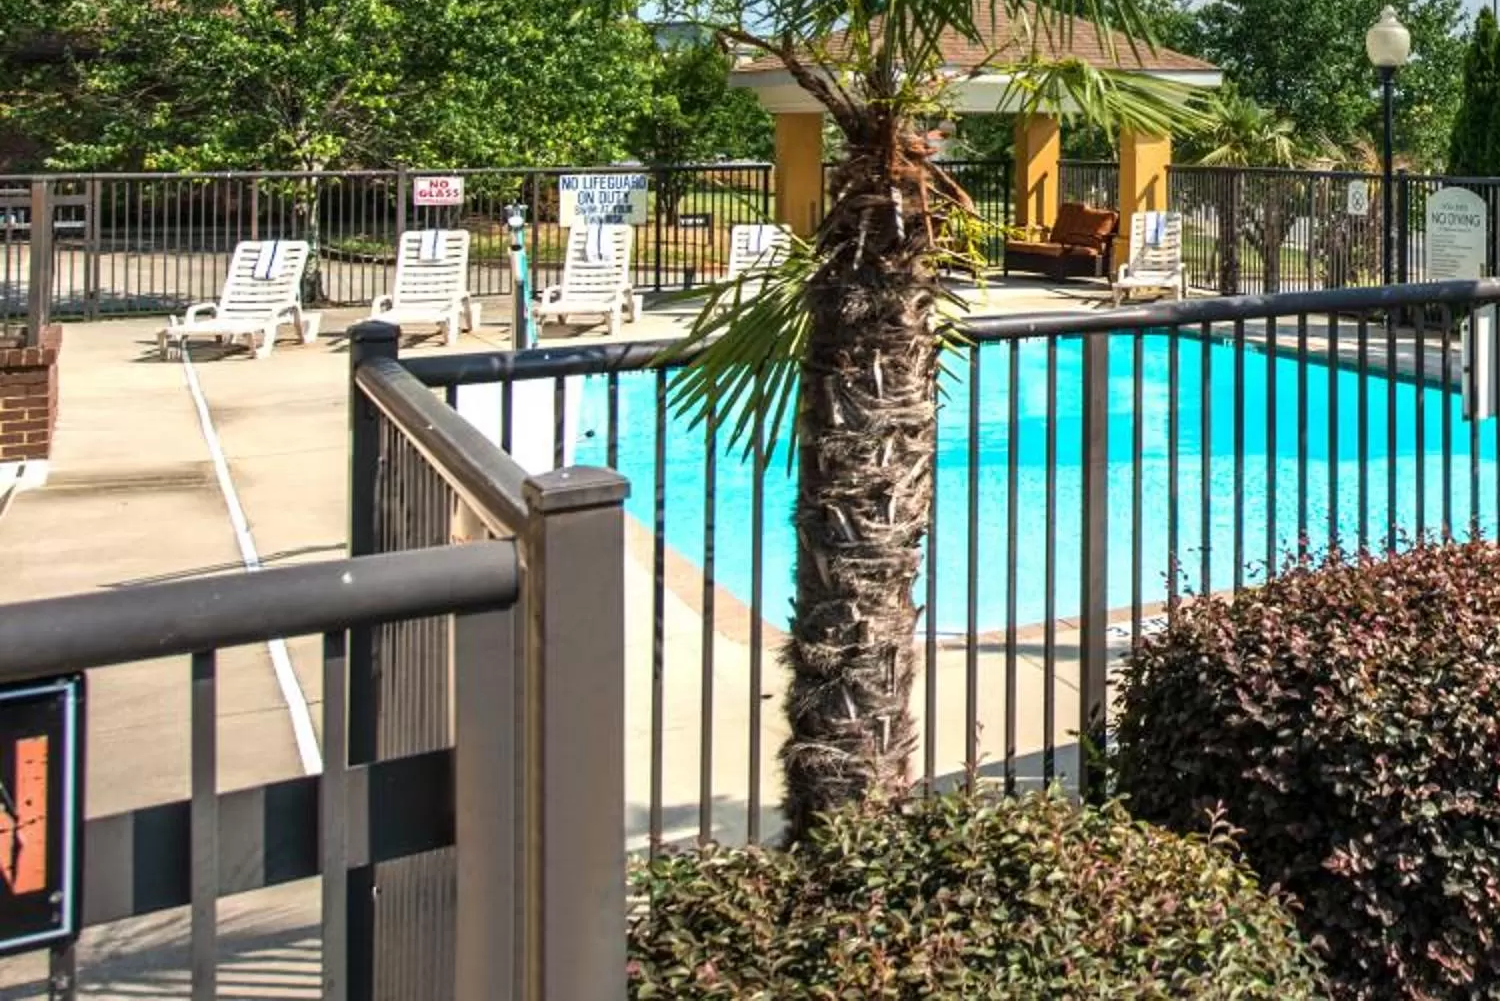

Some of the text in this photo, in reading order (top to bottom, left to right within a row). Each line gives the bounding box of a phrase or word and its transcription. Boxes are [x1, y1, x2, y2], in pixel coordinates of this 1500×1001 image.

[429, 180, 449, 188] NO
[561, 176, 647, 190] NO LIFEGUARD
[418, 189, 459, 198] GLASS
[577, 190, 631, 204] ON DUTY
[1432, 212, 1480, 228] NO DIVING
